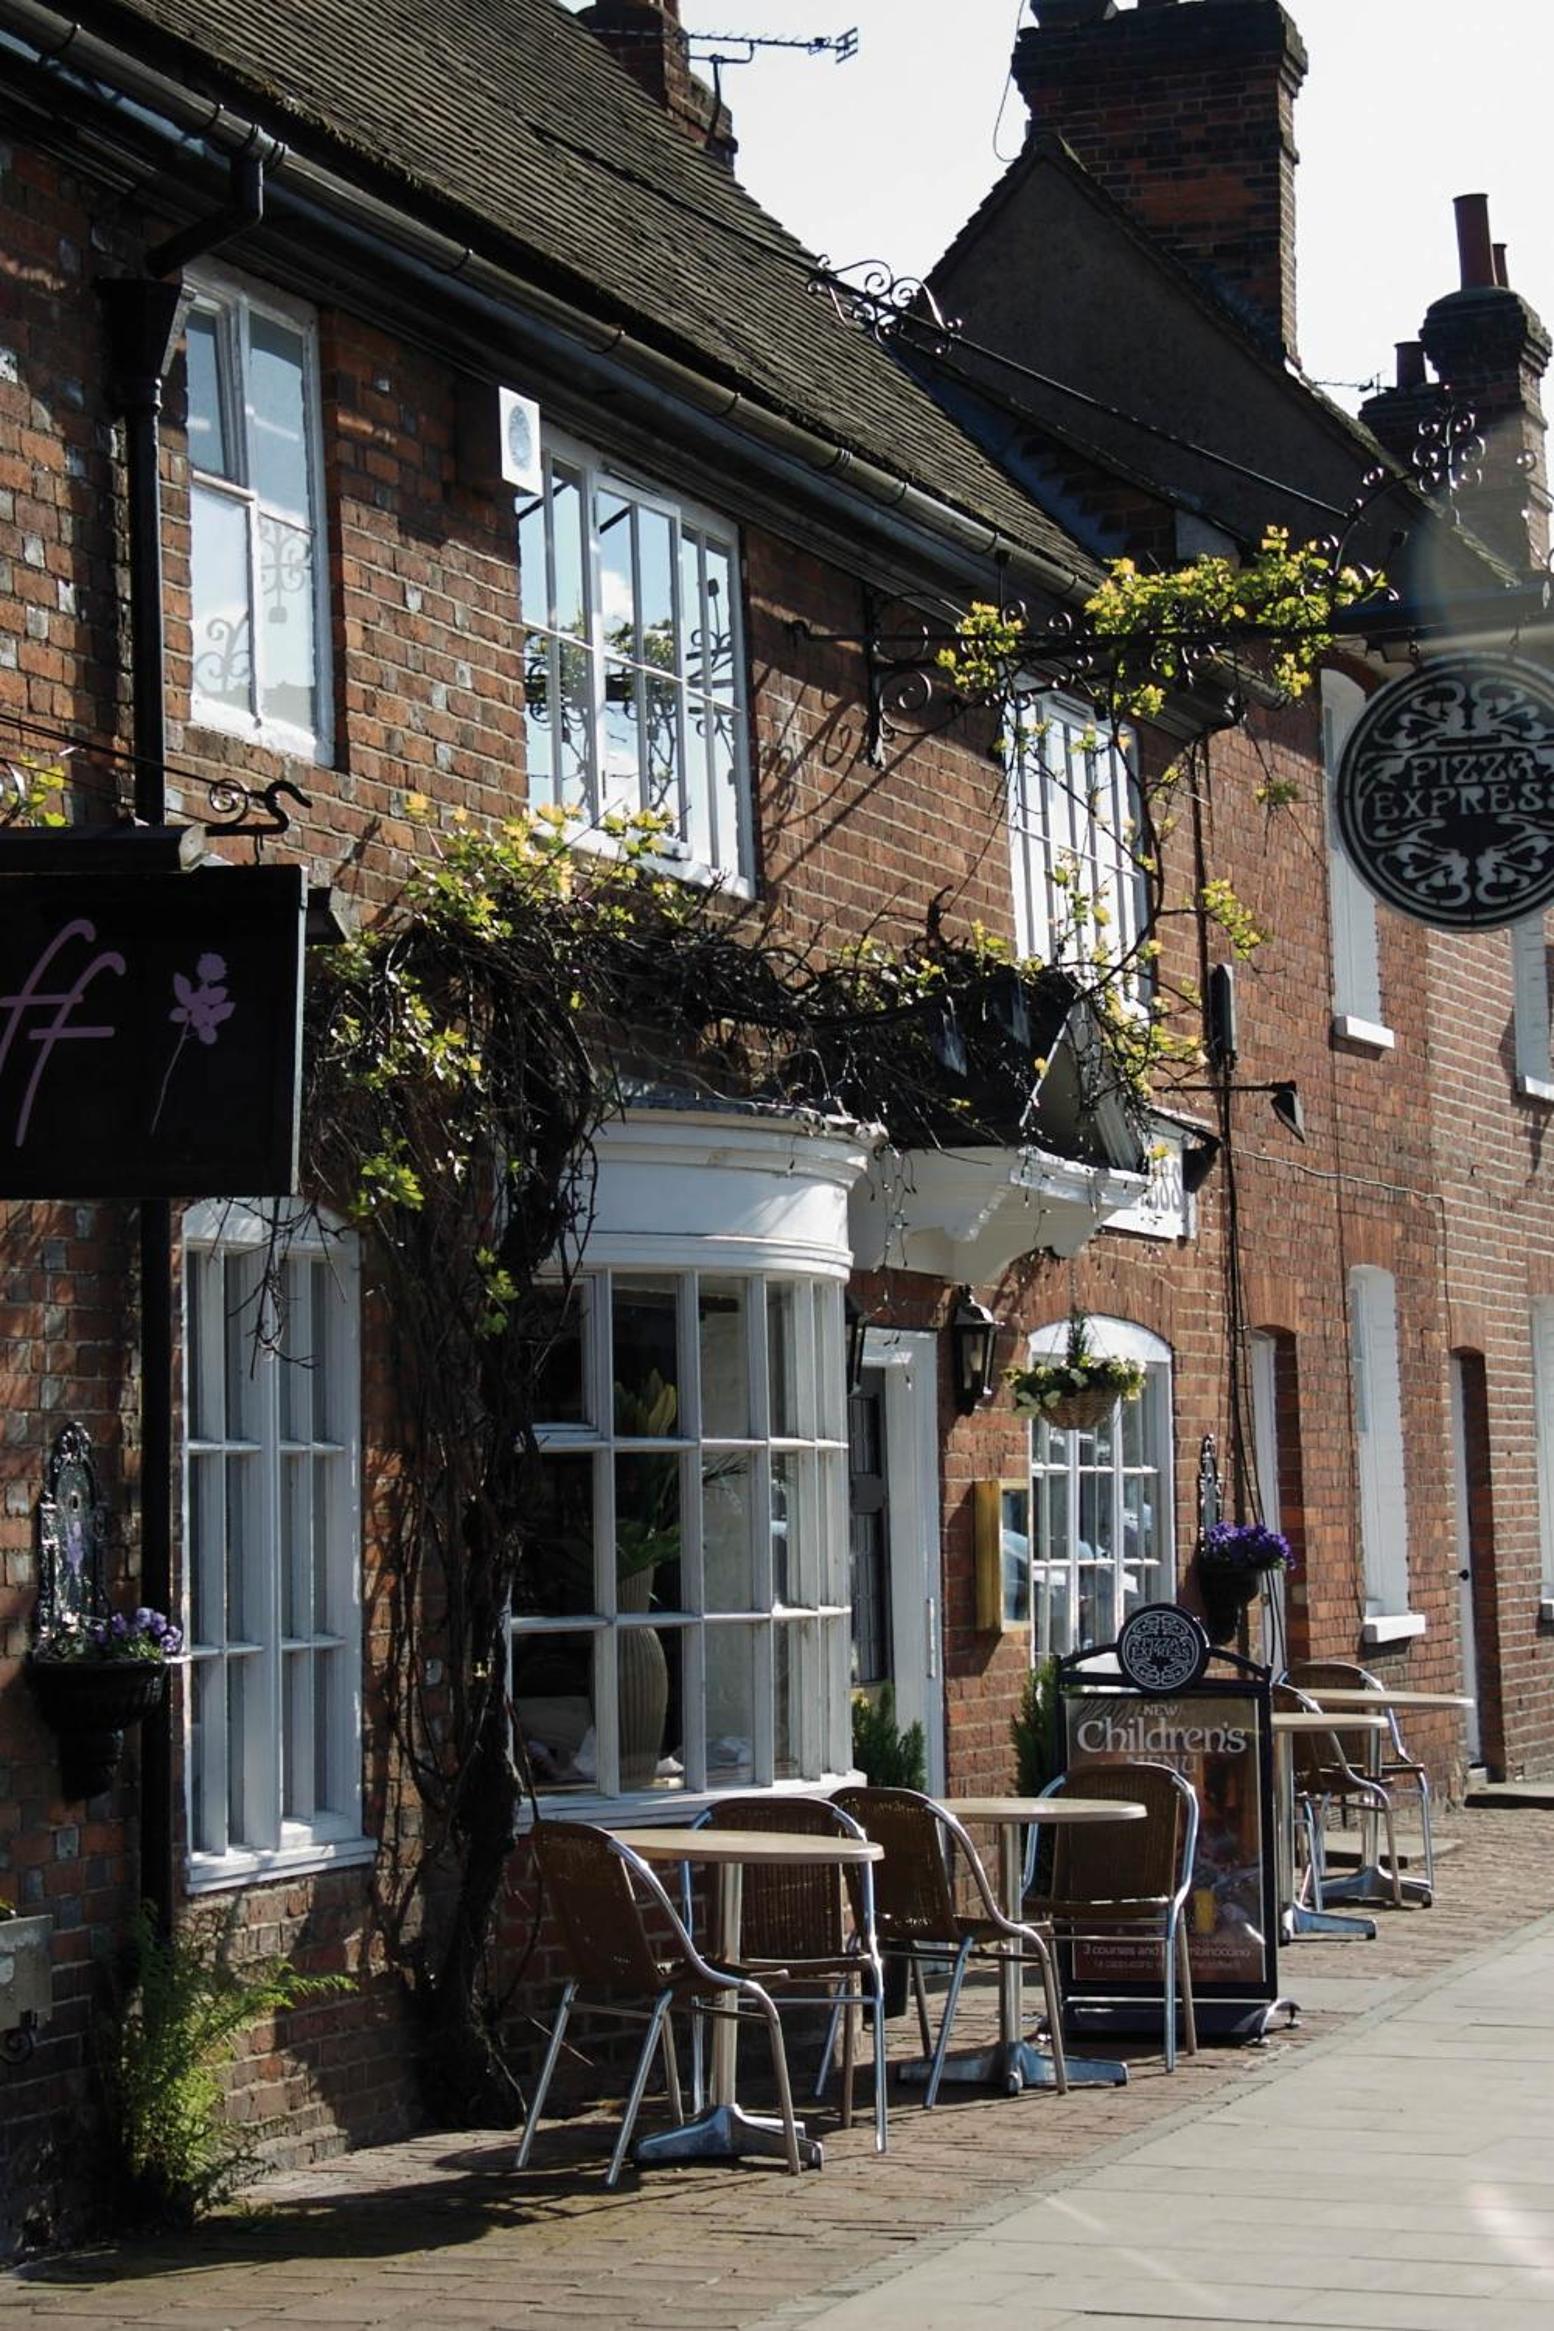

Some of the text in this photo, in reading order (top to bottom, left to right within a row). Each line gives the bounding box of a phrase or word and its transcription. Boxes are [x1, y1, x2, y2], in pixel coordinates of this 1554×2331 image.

[1409, 751, 1537, 787] PIZZA
[1373, 783, 1554, 820] EXPRES
[1131, 1645, 1190, 1657] EXPRESS
[1141, 1636, 1179, 1647] PIZZA
[1142, 1704, 1180, 1717] NEW
[1076, 1716, 1248, 1754] Children's
